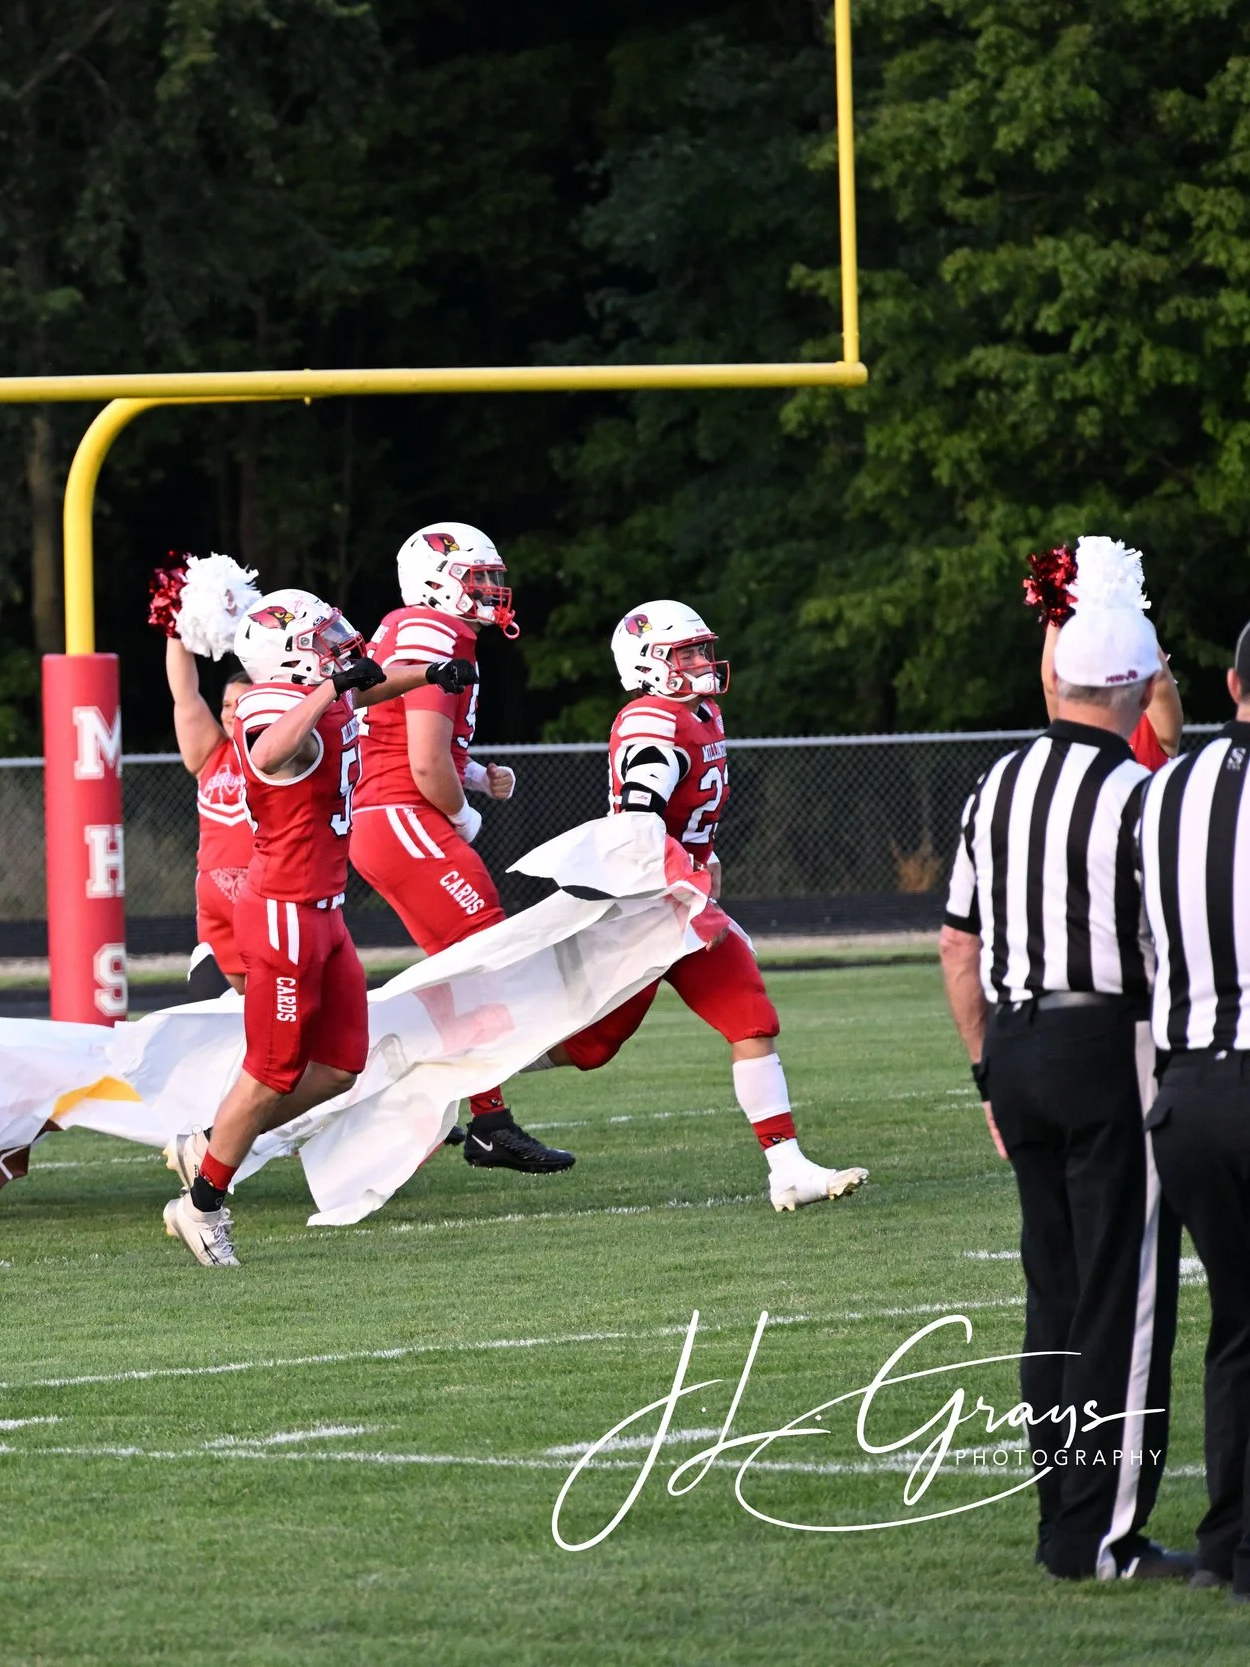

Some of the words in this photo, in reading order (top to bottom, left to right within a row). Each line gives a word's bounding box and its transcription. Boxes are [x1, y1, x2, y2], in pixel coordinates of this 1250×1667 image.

[681, 765, 728, 843] 2
[440, 870, 485, 915] CARDS
[276, 976, 297, 1023] CARDS
